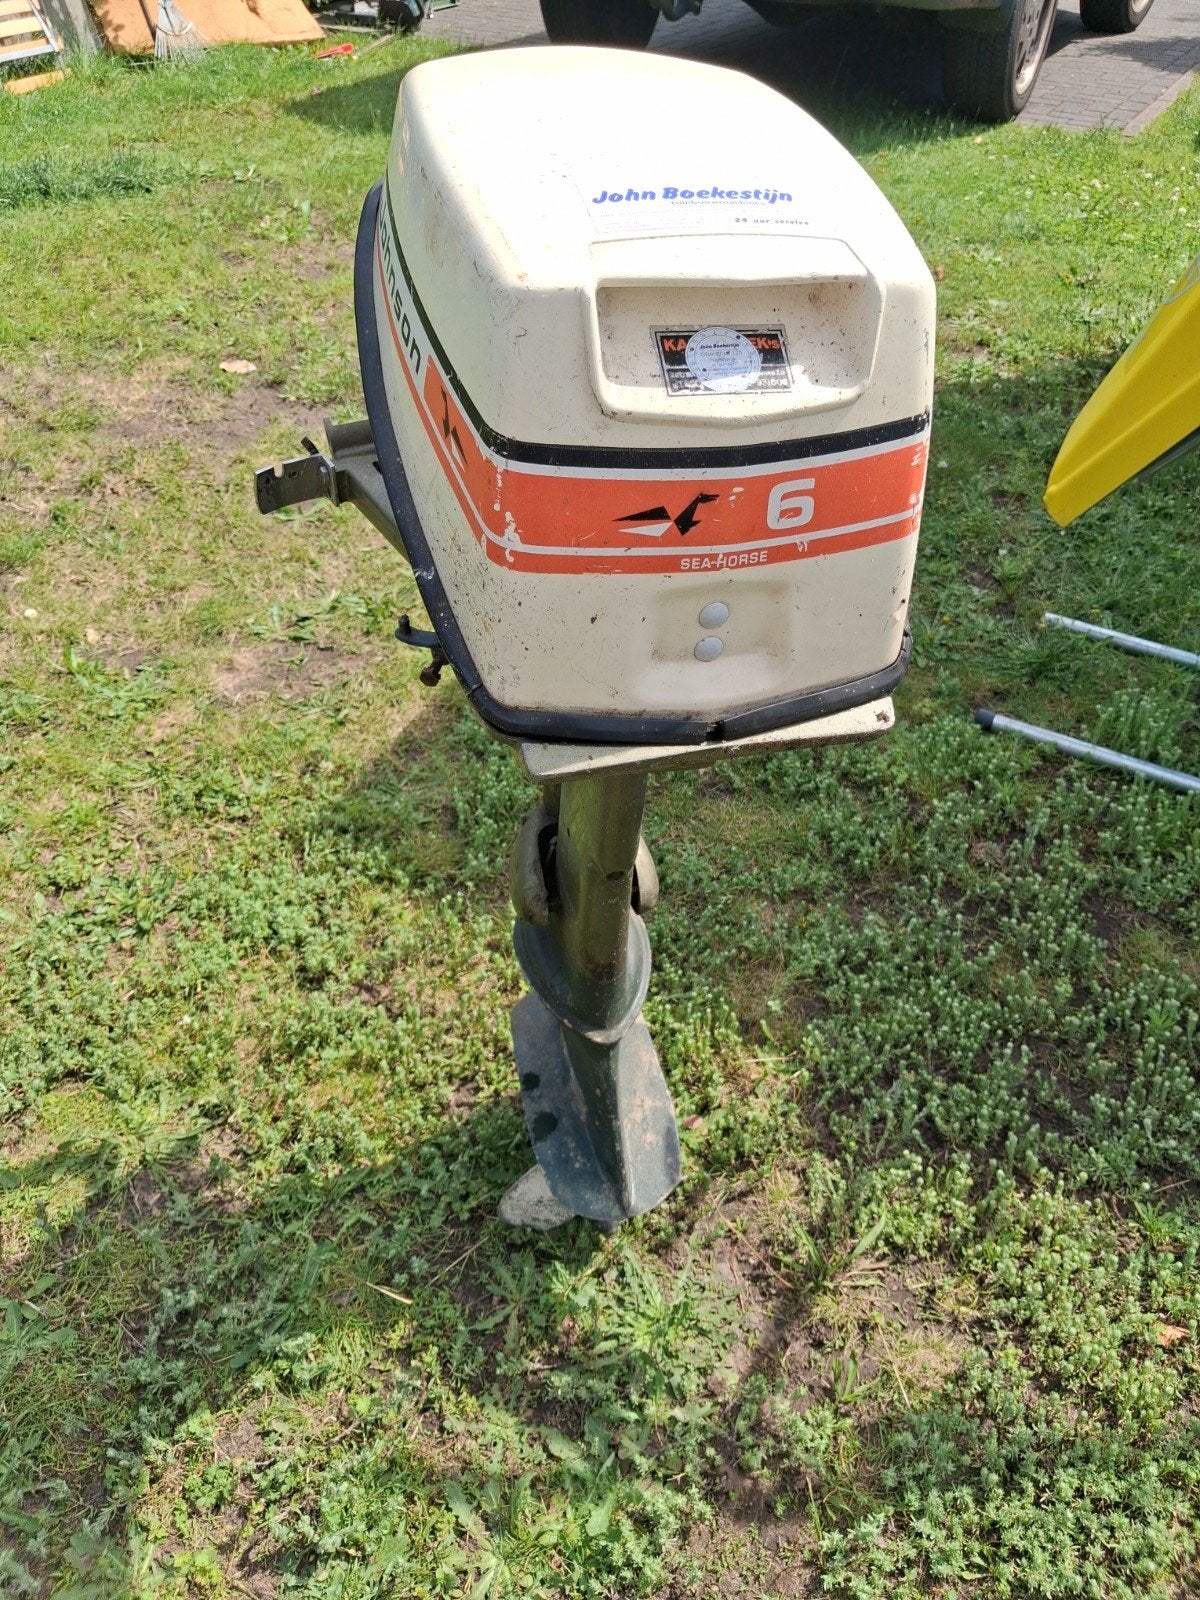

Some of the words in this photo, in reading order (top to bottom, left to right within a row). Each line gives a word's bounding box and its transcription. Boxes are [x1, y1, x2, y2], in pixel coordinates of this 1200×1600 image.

[592, 188, 656, 204] John
[662, 186, 793, 205] Boekestijn
[378, 201, 422, 374] Johnson
[766, 477, 816, 530] 6
[680, 550, 768, 570] SEA-HORSE
